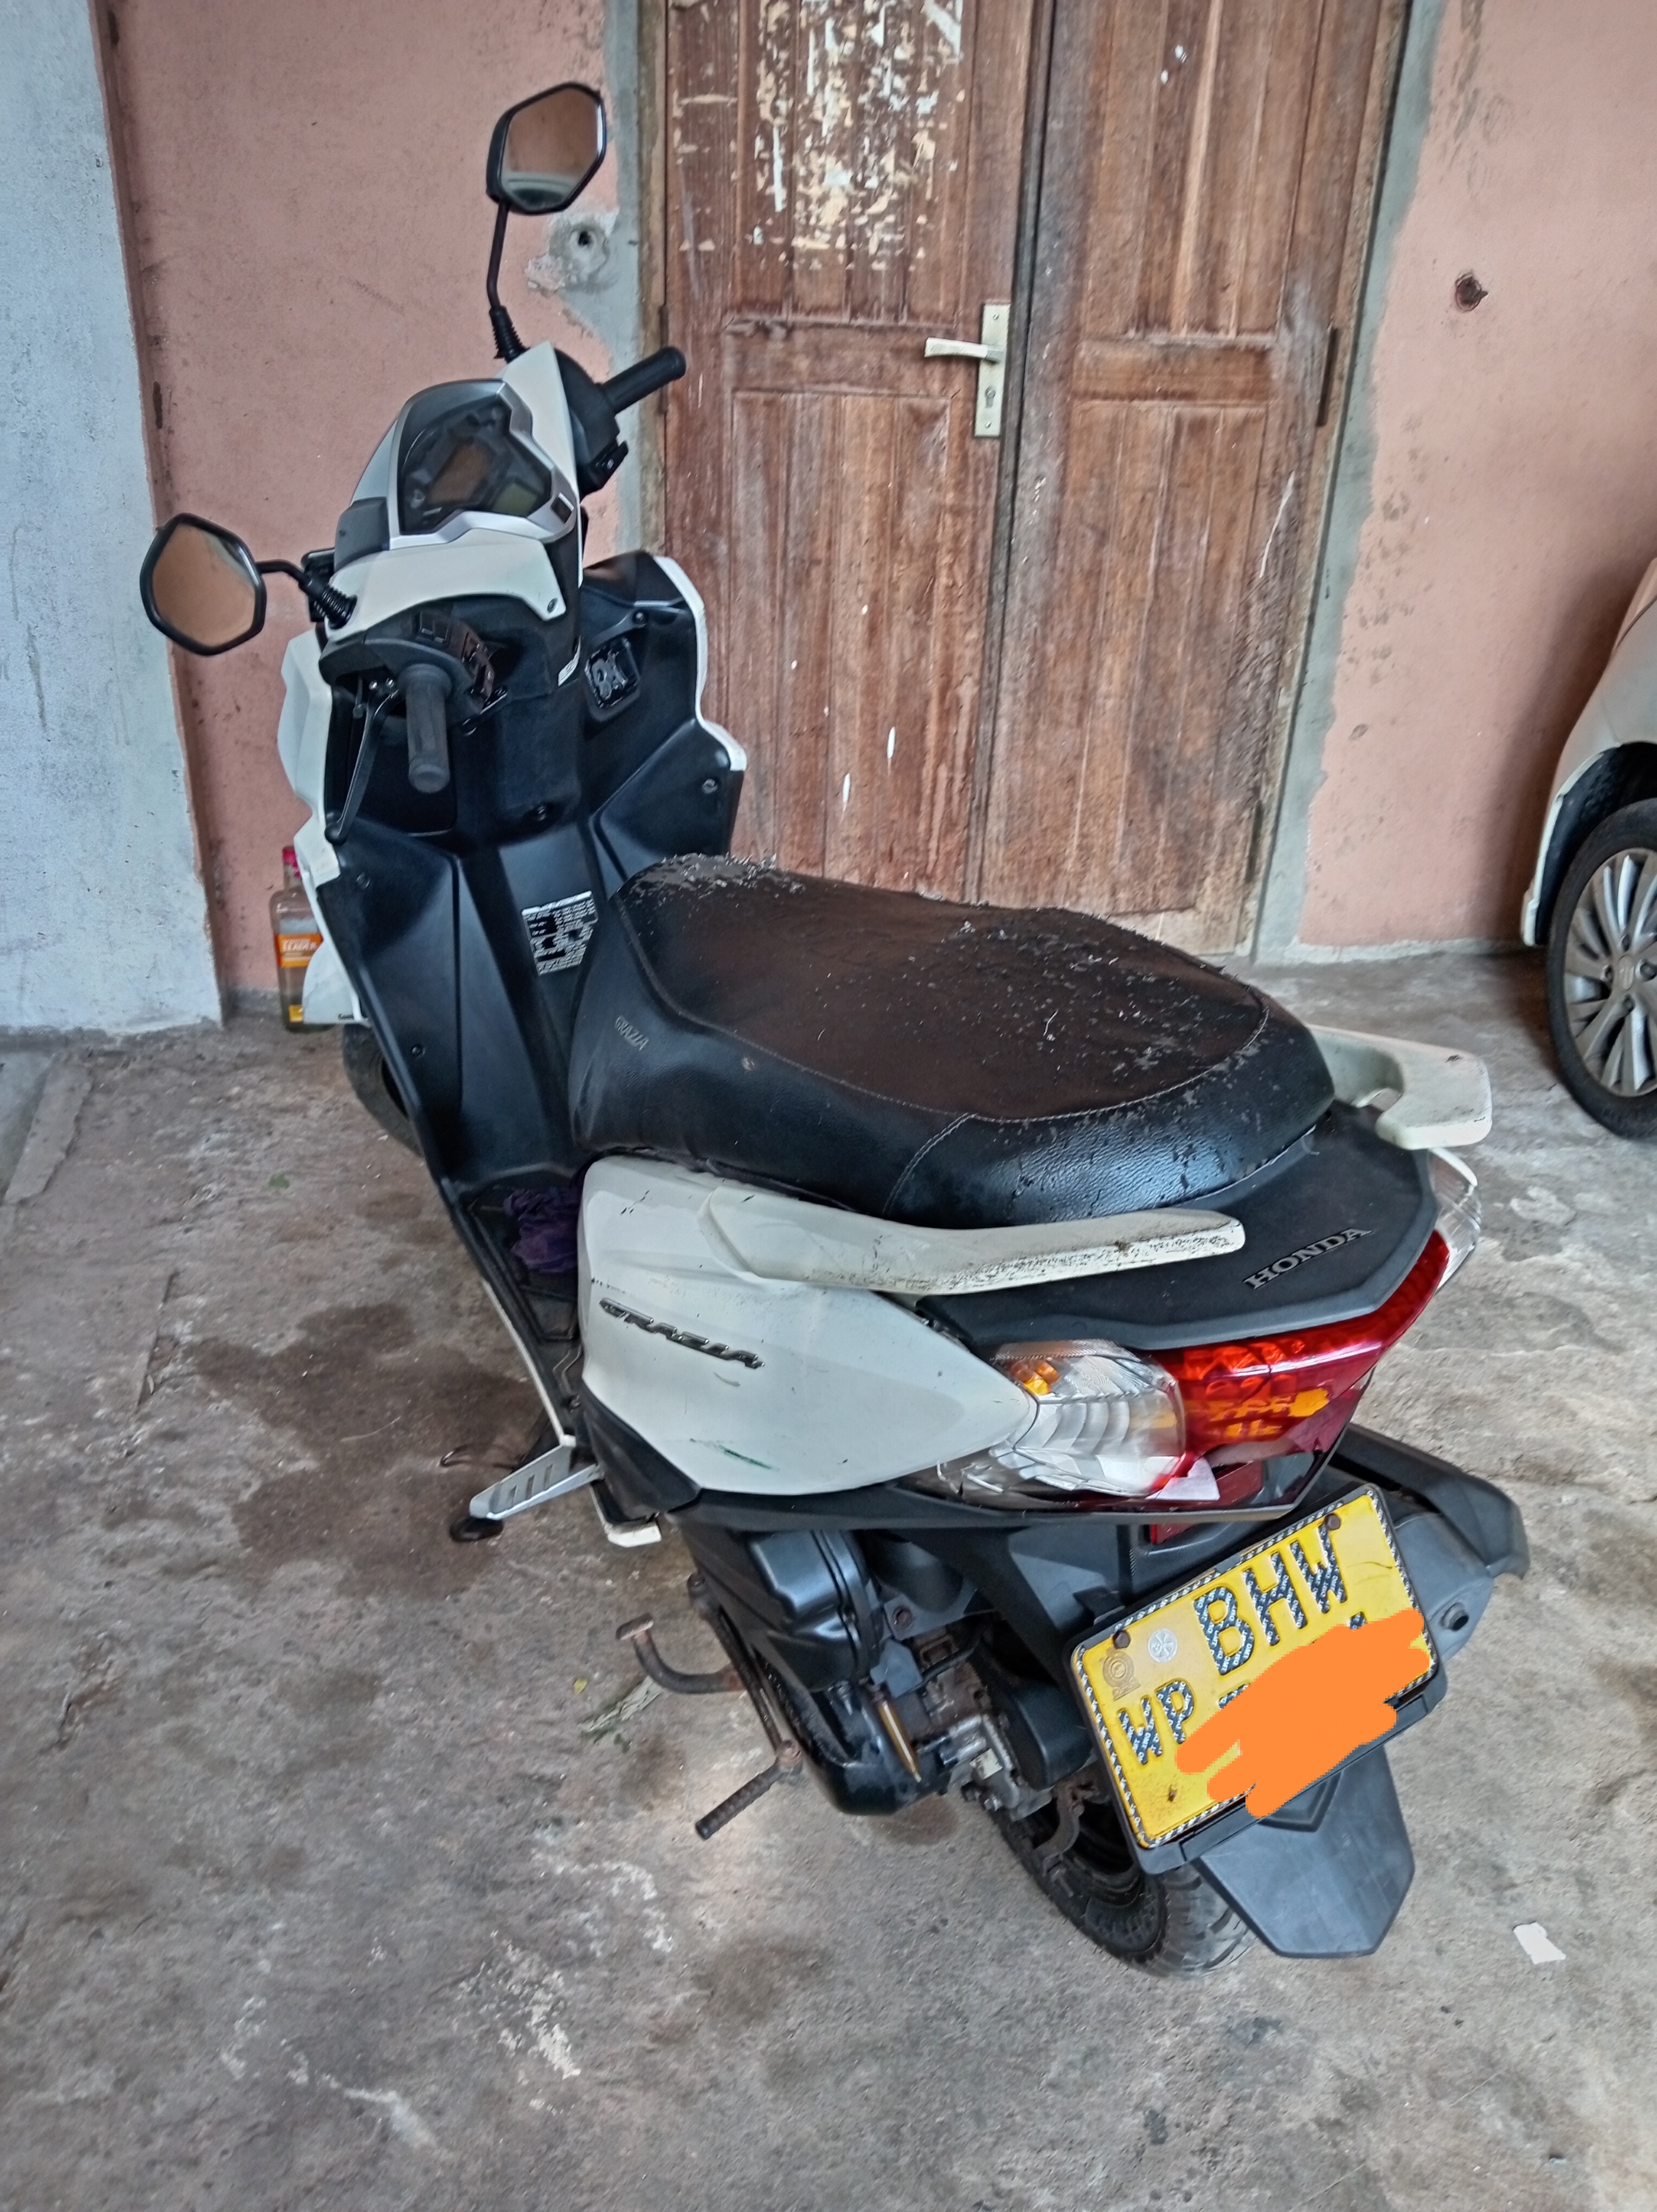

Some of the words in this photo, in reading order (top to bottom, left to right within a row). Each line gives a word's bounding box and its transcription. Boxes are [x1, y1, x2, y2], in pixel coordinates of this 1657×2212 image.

[1242, 1227, 1373, 1290] HONDA
[1192, 1521, 1348, 1676] BHW
[1117, 1679, 1195, 1765] WP
